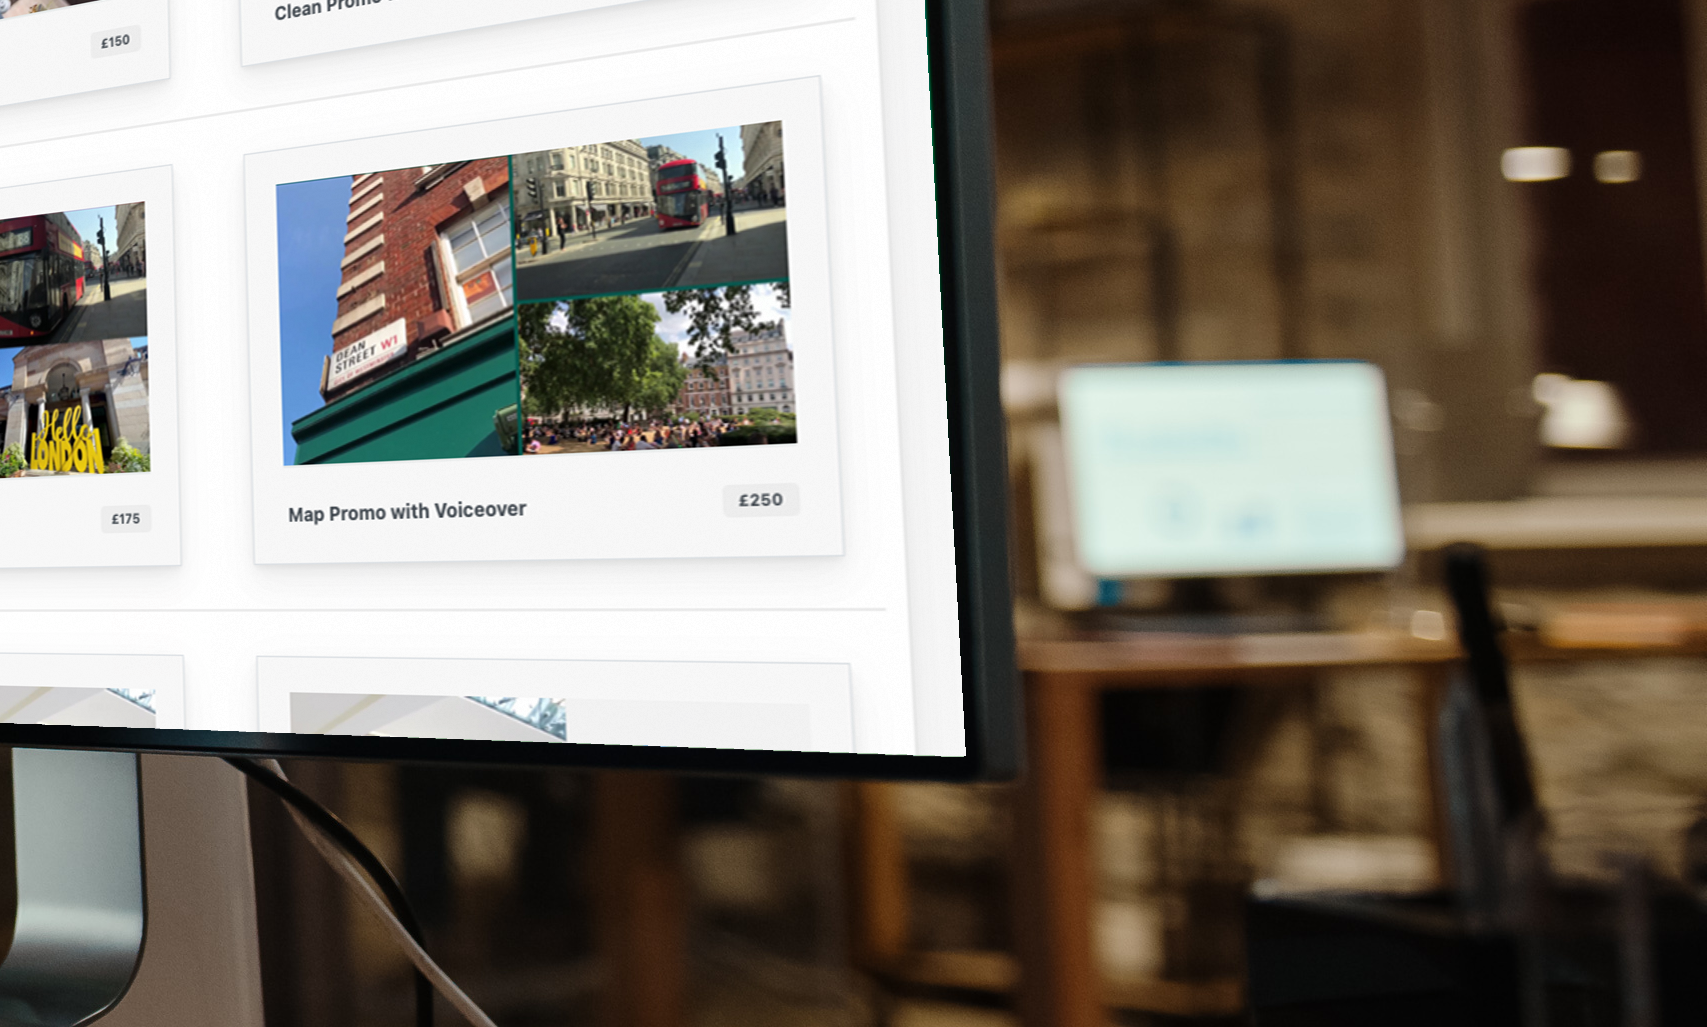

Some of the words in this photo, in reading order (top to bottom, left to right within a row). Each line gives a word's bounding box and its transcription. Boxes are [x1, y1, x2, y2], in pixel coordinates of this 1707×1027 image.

[101, 34, 130, 49] £150
[335, 344, 376, 374] STREET
[380, 335, 397, 350] W1
[336, 341, 365, 362] DEAN
[35, 405, 90, 441] Hello
[30, 428, 104, 474] LONDON
[738, 492, 783, 507] £250
[112, 513, 140, 524] £175
[288, 507, 325, 525] Map
[330, 505, 386, 521] Promo
[392, 503, 429, 519] with
[434, 501, 526, 518] Voiceover
